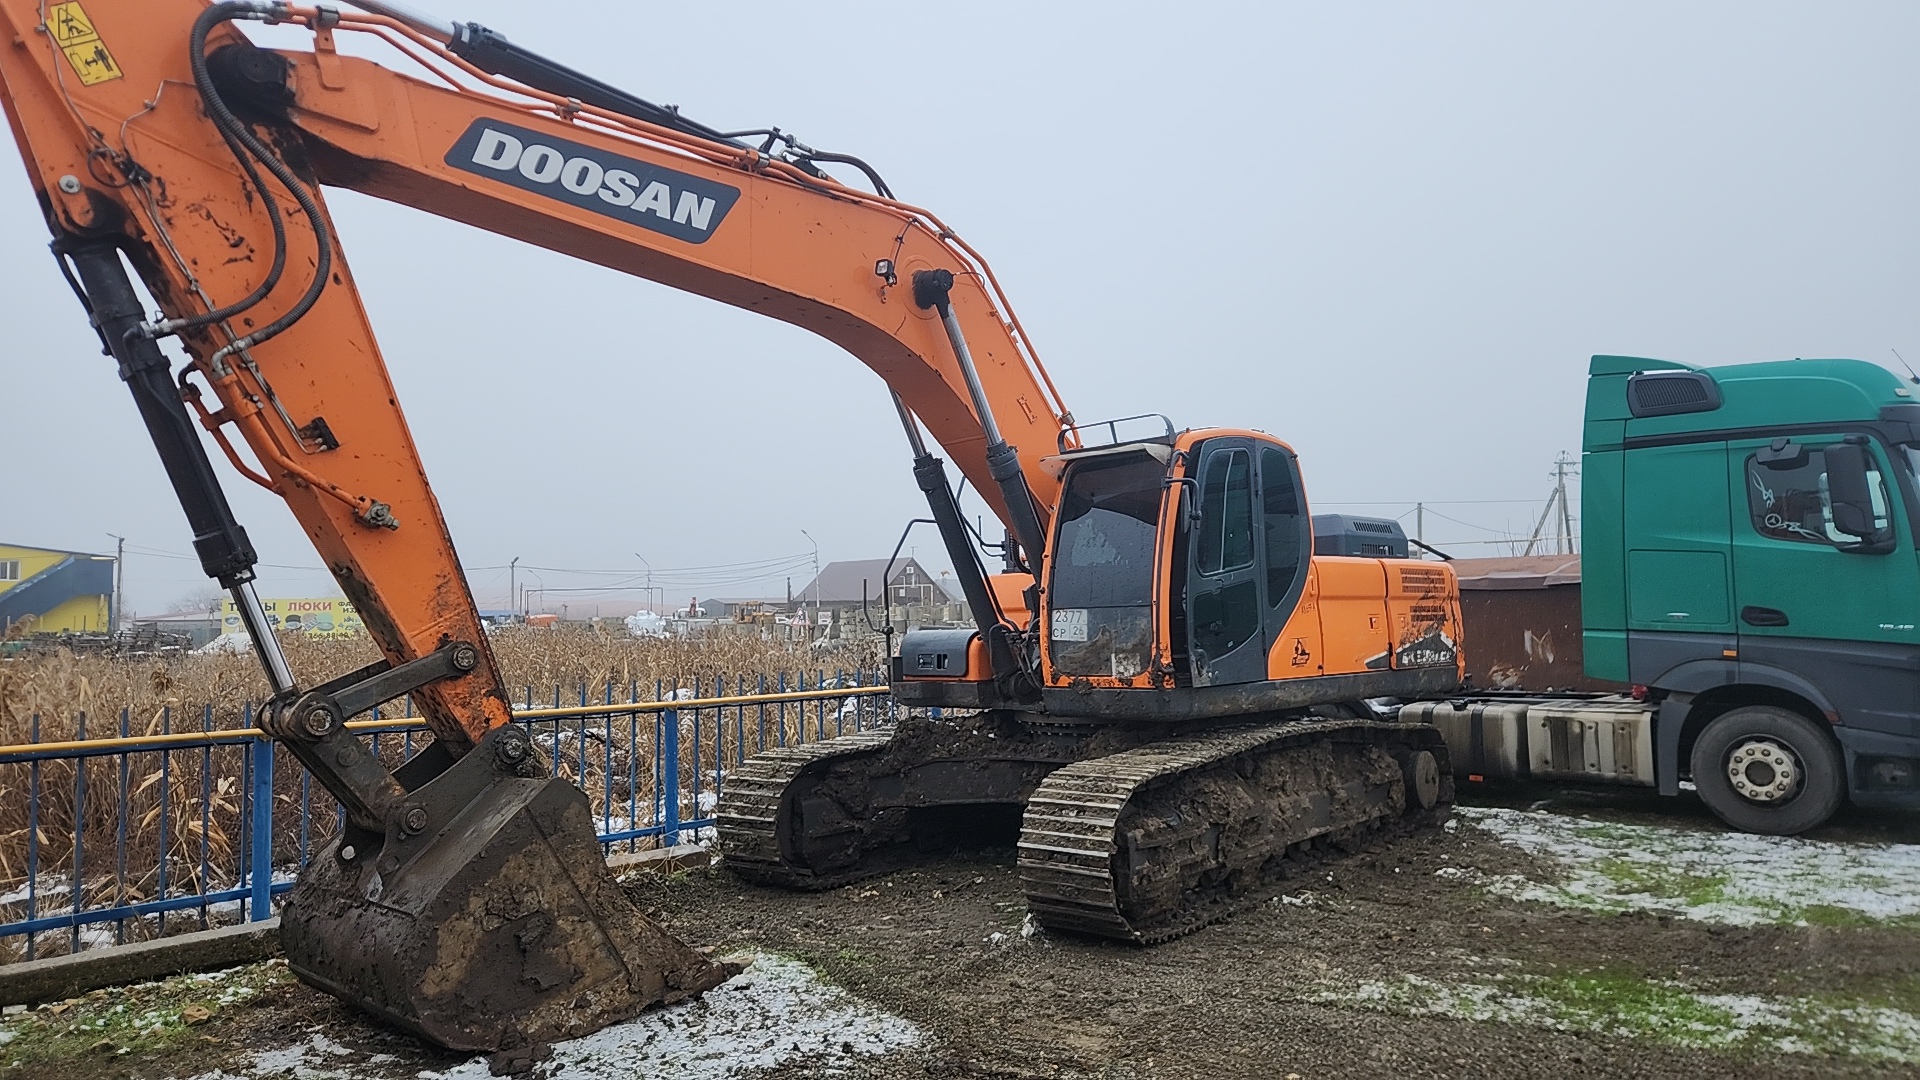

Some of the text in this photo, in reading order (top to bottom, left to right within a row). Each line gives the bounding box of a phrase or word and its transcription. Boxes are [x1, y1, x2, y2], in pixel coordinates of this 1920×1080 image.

[472, 128, 716, 231] DOOSAN
[287, 602, 332, 611] ЛЮКИ
[1055, 610, 1082, 623] 2377
[1073, 626, 1084, 635] 26
